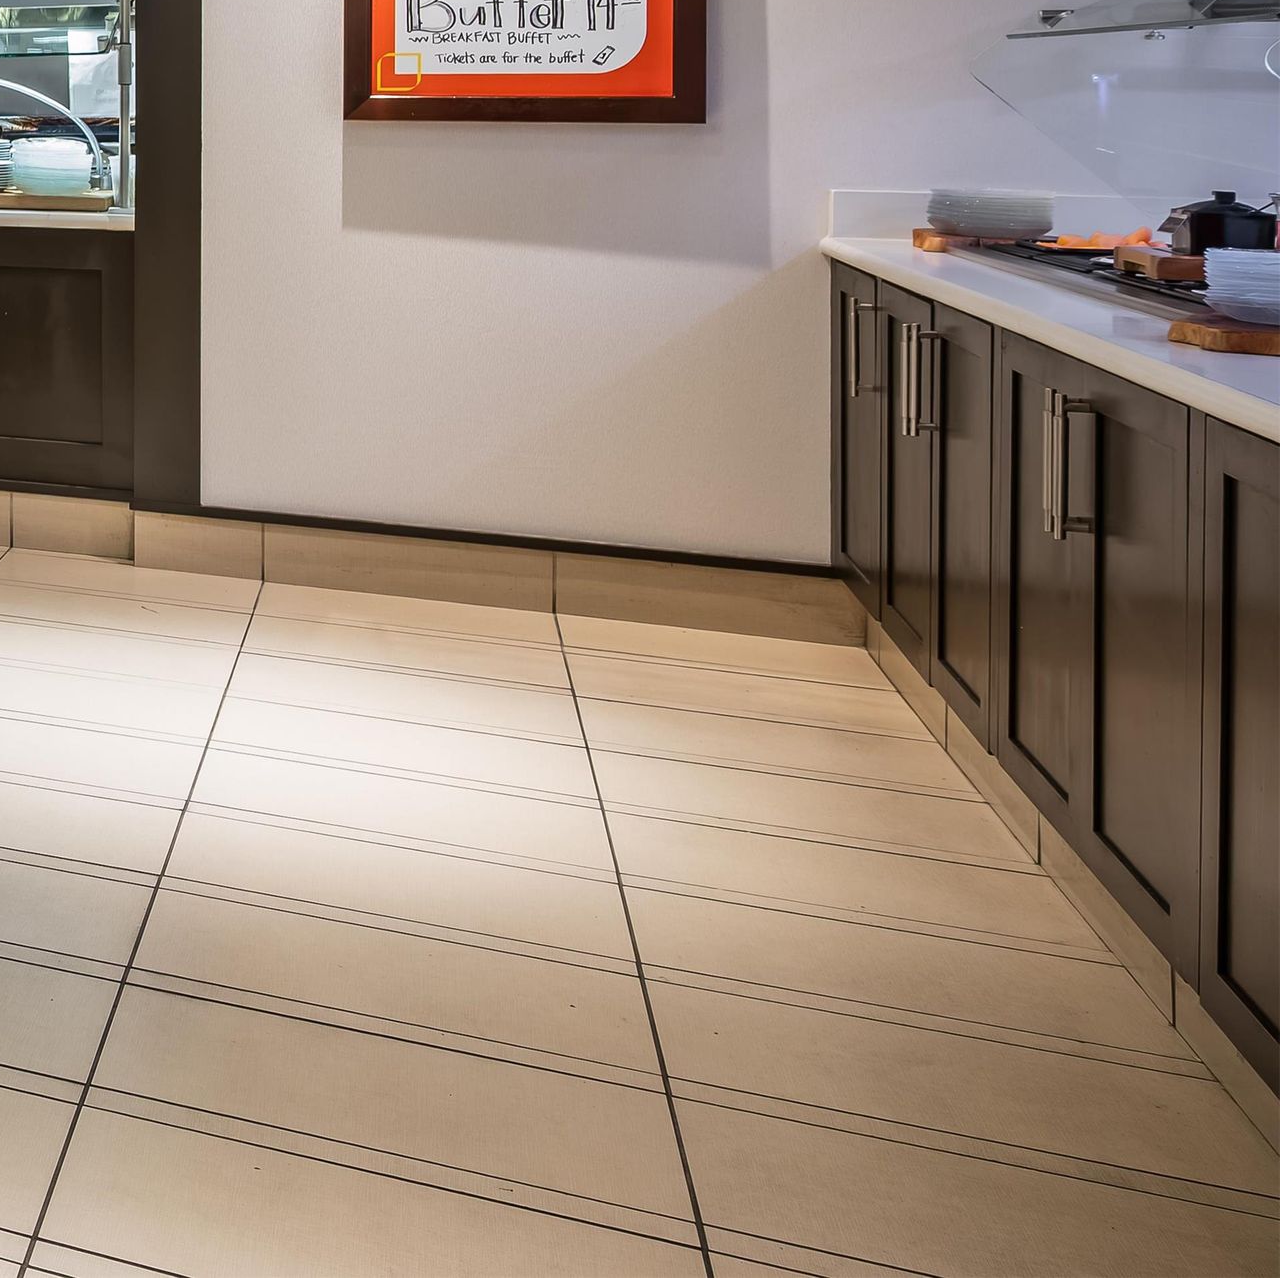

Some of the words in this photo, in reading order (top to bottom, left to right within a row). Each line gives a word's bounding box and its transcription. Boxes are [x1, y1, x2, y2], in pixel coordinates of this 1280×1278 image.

[432, 32, 502, 44] BREAKFAST
[508, 32, 552, 45] BUFFET
[435, 51, 475, 64] Tickets
[479, 52, 497, 64] are
[502, 50, 519, 64] for
[524, 50, 542, 64] the
[549, 49, 586, 64] buffet
